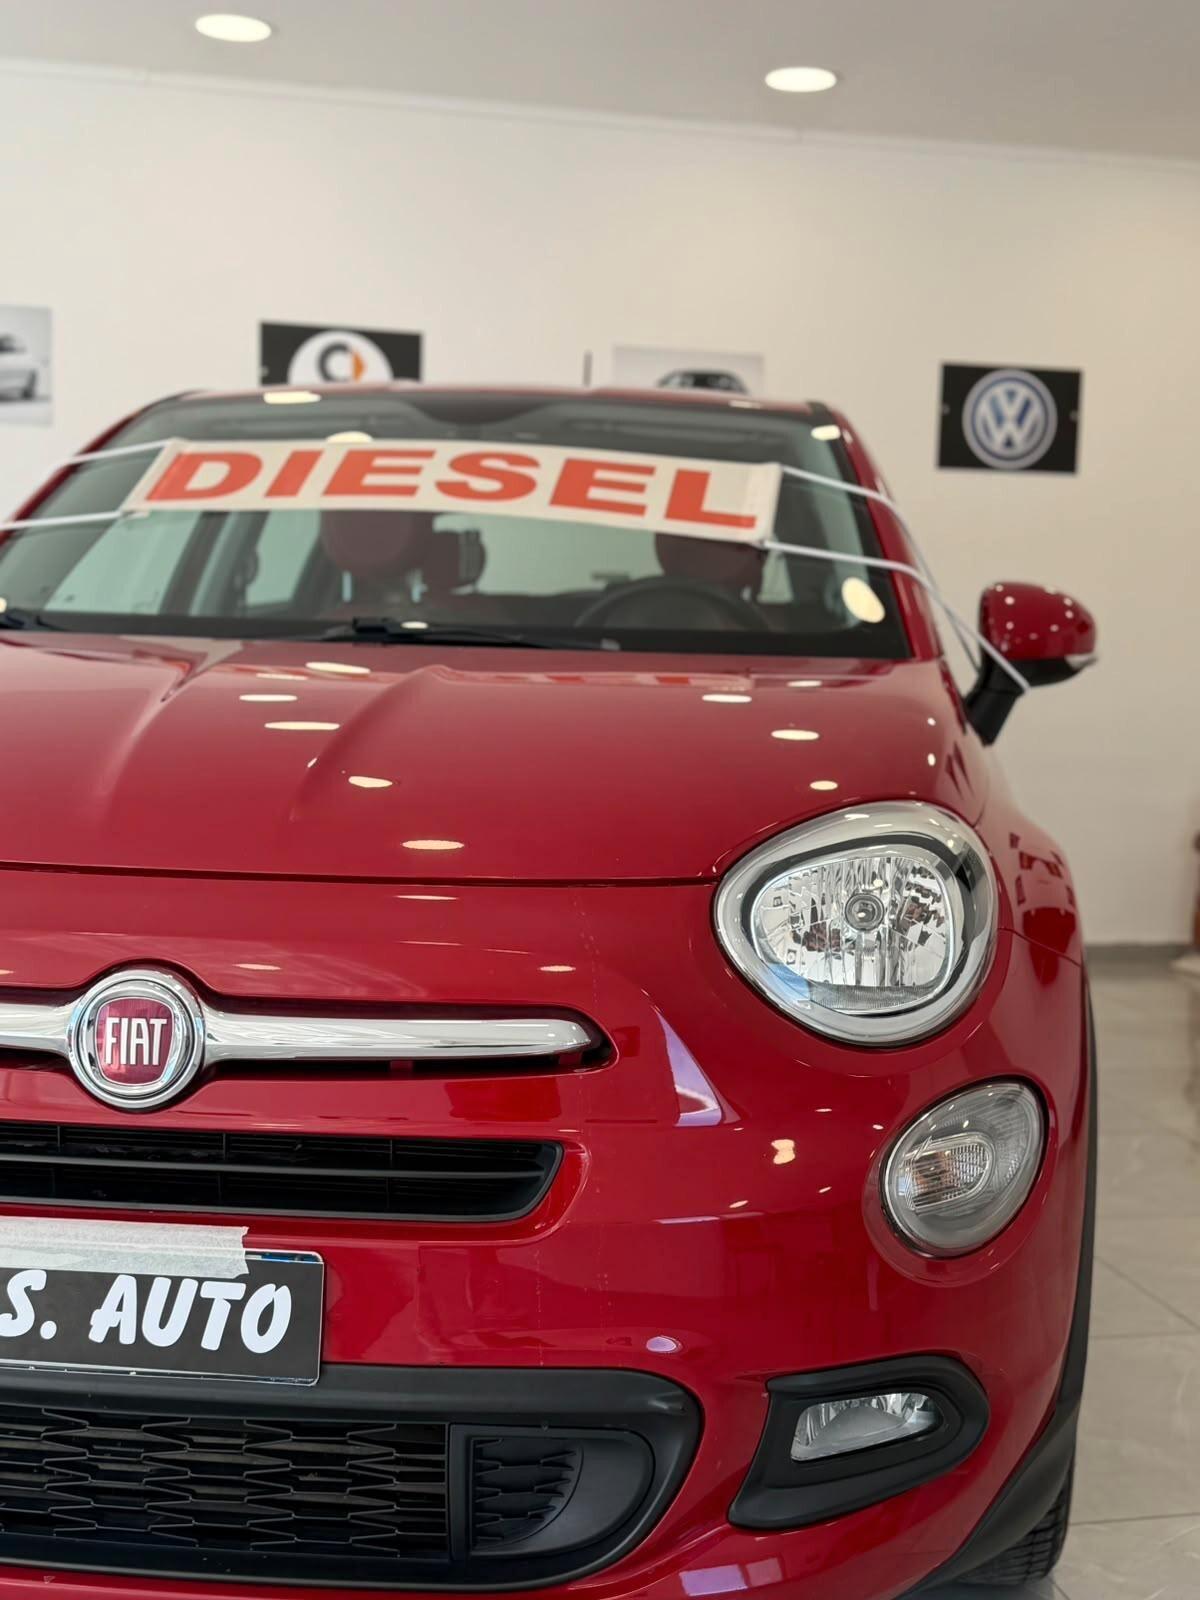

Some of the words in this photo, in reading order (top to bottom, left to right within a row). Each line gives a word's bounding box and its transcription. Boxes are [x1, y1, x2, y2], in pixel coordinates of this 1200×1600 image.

[146, 449, 757, 529] DIESEL
[105, 1017, 167, 1066] FIAT
[0, 1269, 57, 1340] S.
[88, 1274, 292, 1353] AUTO
